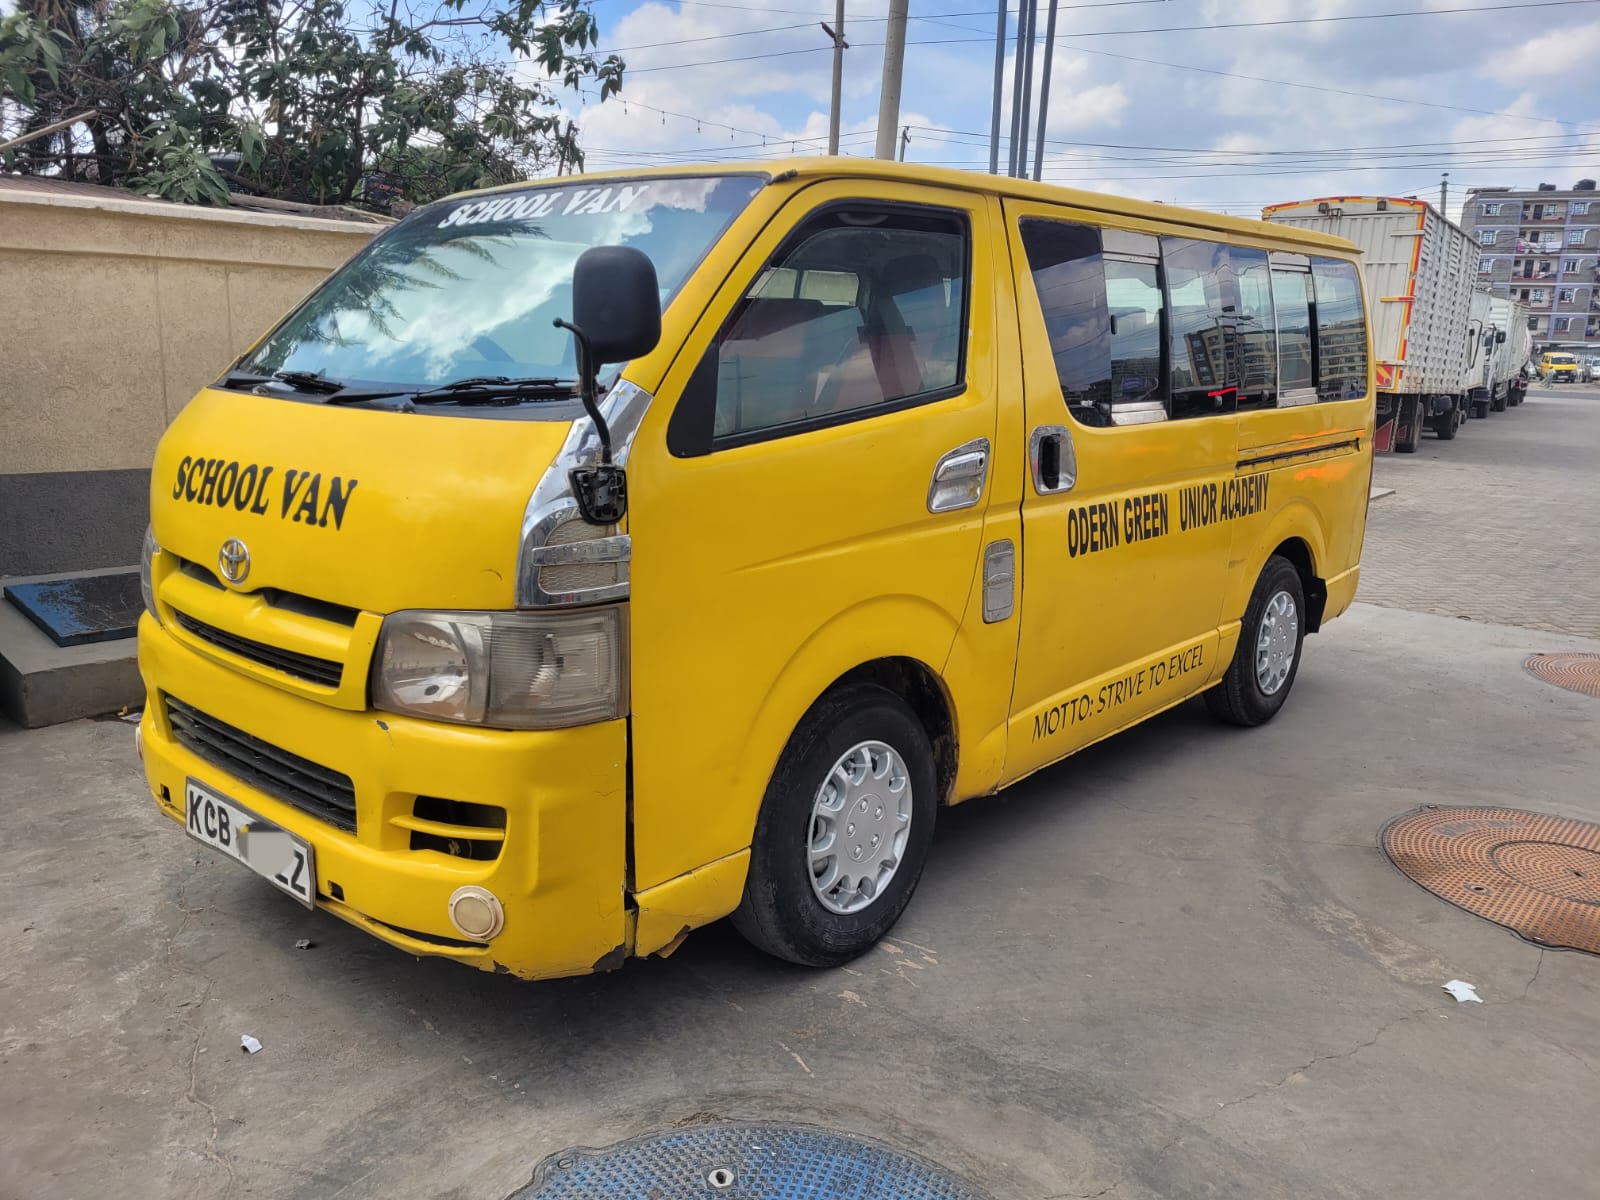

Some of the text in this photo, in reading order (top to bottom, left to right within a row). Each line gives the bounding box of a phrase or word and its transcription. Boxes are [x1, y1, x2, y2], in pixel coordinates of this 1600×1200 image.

[437, 185, 650, 229] SCHOOL VAN
[172, 455, 358, 532] SCHOOL VAN
[1067, 472, 1270, 559] ODERN GREEN UNIOR ACADEMY
[1031, 644, 1204, 745] MOTTO: STRIVE TO EXCEL
[189, 790, 231, 847] KCB
